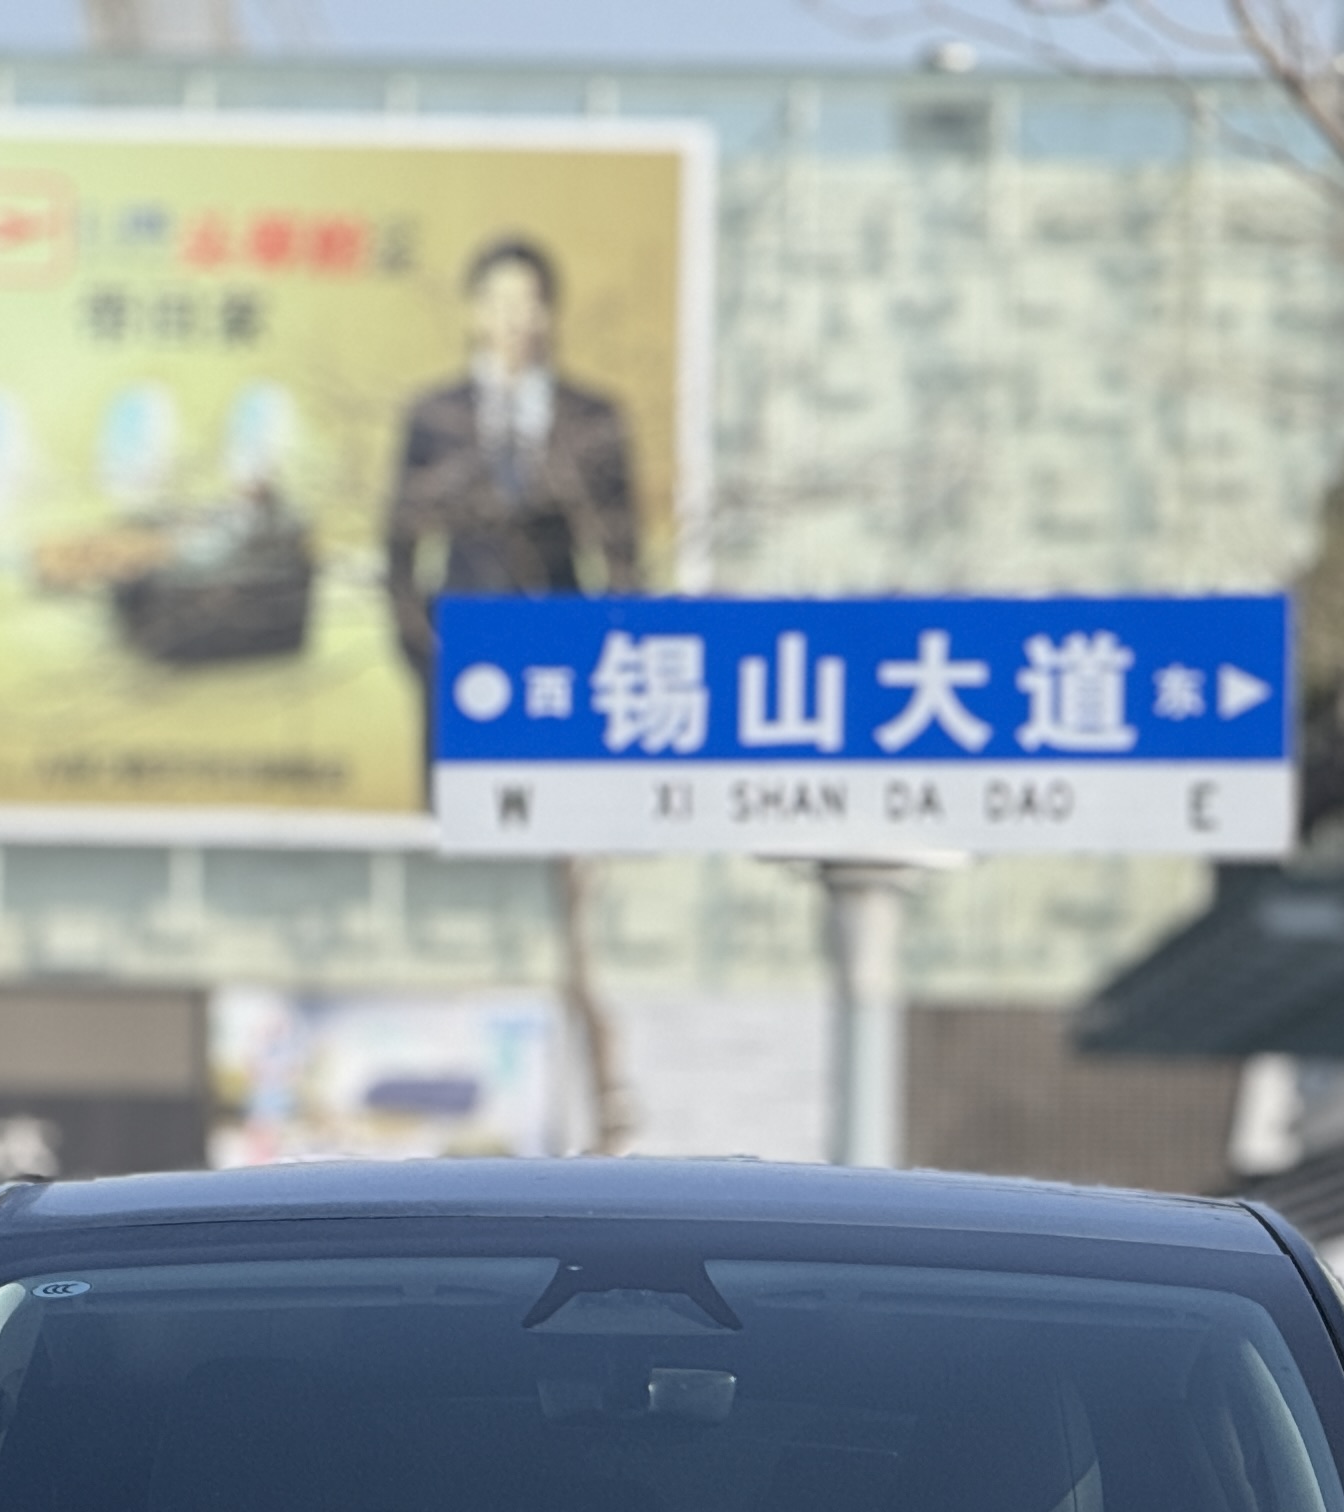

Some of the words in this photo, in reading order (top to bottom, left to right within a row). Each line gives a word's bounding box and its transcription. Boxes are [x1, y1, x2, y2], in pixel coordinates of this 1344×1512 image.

[523, 665, 575, 719] 西
[590, 630, 1138, 754] 锡山大道
[1153, 665, 1207, 720] 东
[493, 782, 535, 832] W
[654, 780, 695, 822] XI
[727, 778, 850, 824] SHAN
[883, 778, 947, 824] DA
[983, 778, 1075, 824] DAO
[1187, 778, 1221, 833] E
